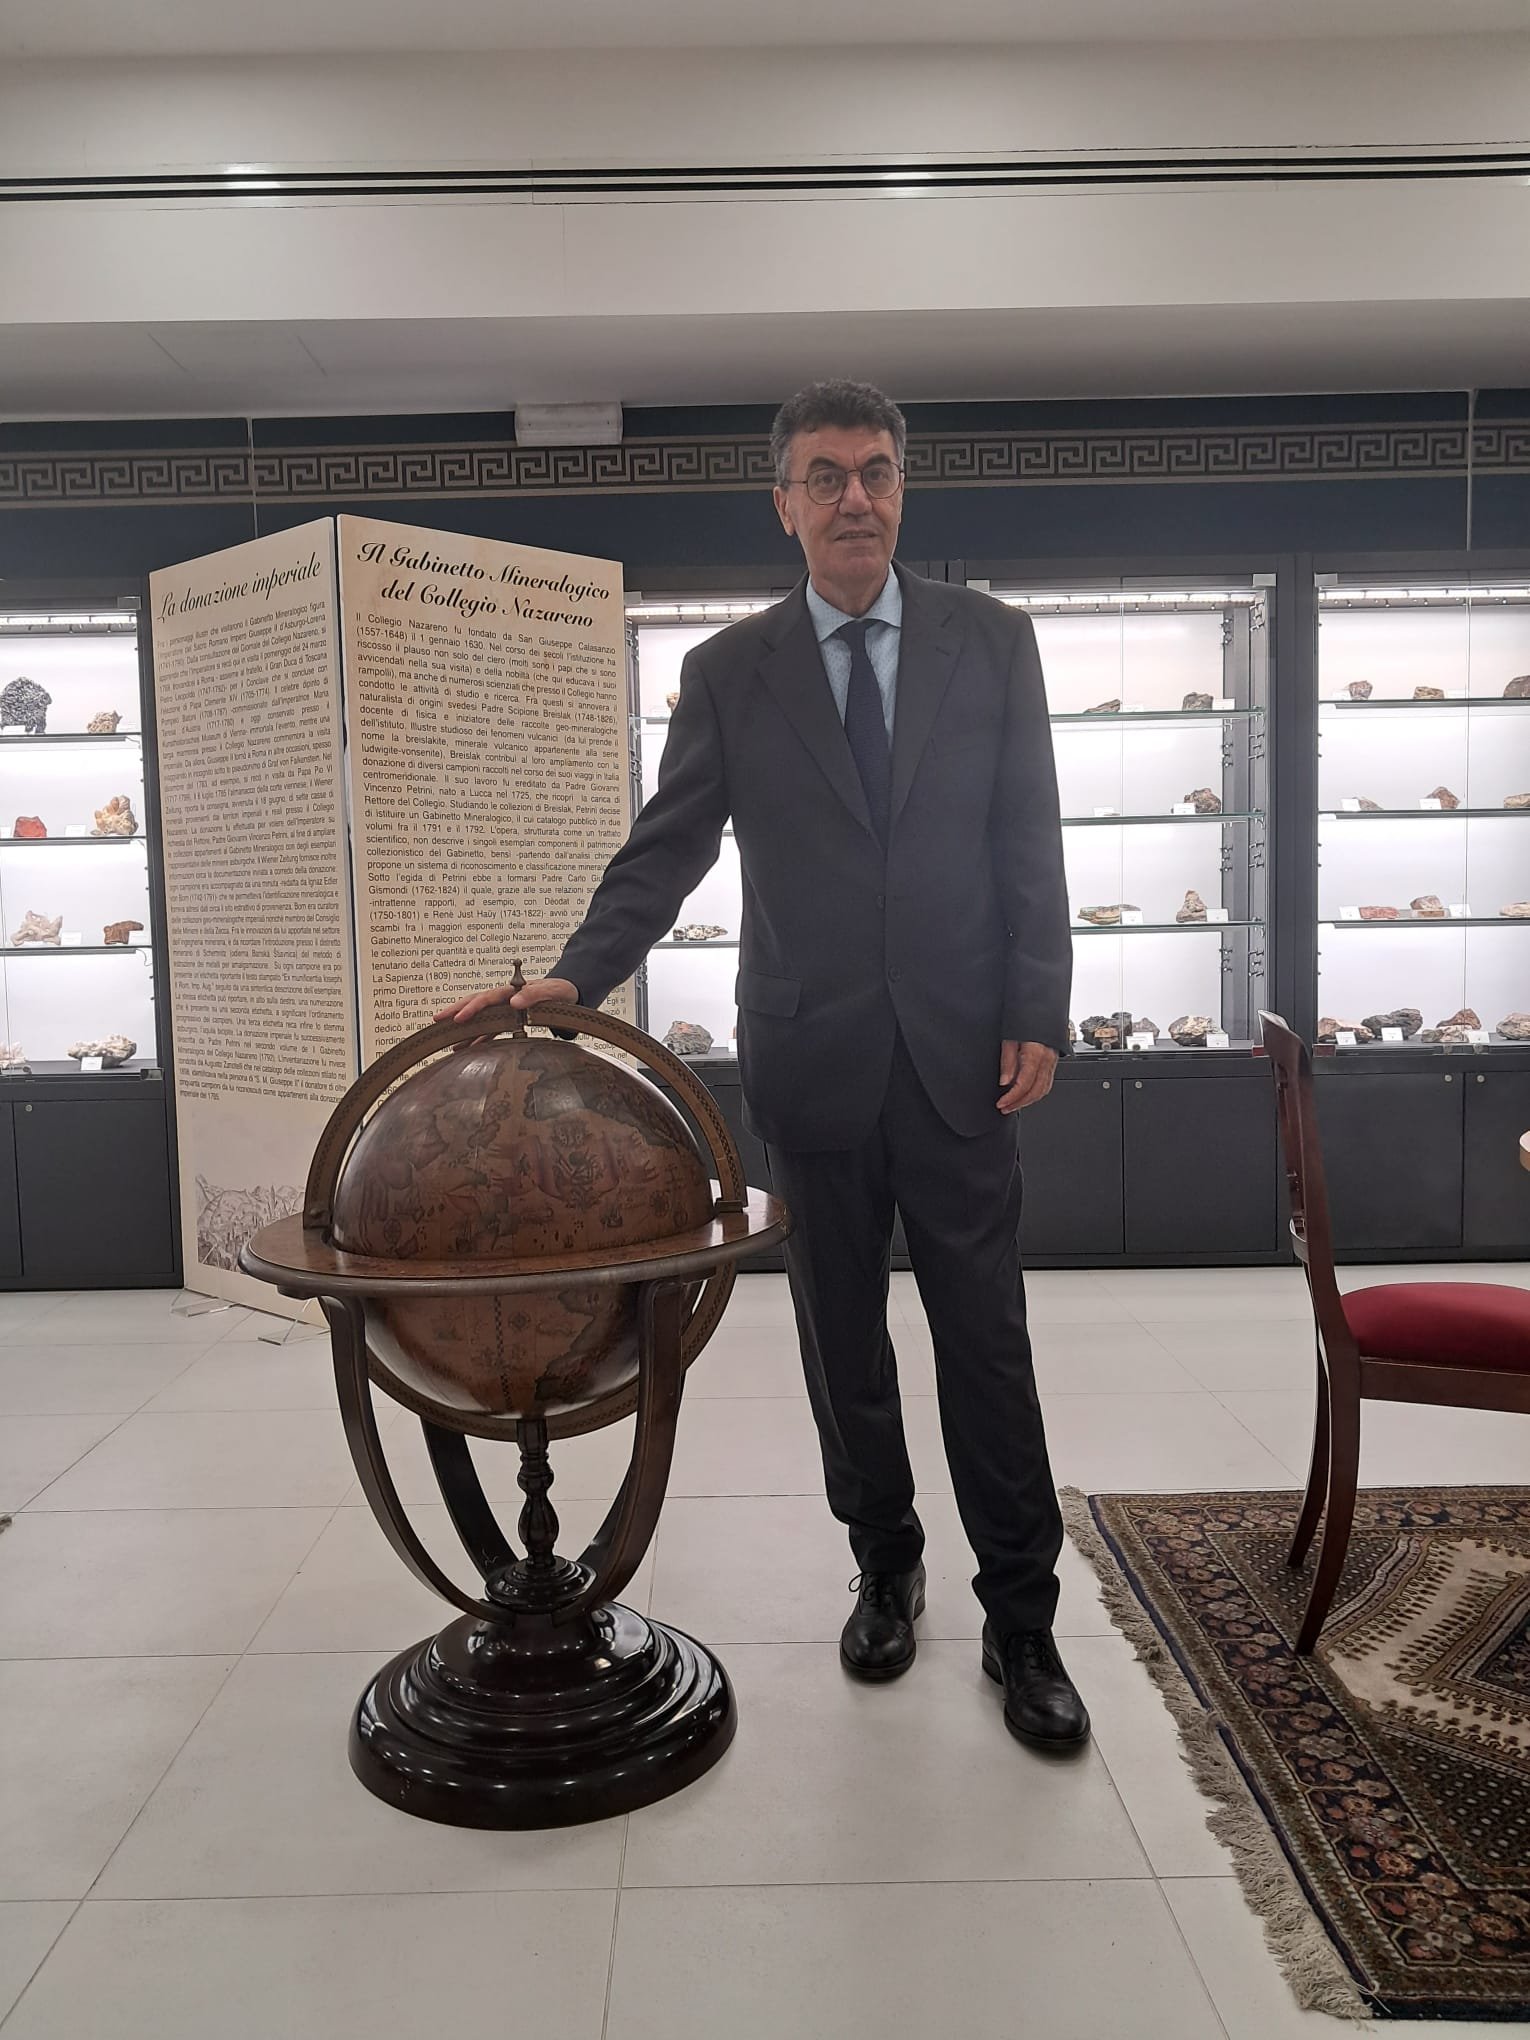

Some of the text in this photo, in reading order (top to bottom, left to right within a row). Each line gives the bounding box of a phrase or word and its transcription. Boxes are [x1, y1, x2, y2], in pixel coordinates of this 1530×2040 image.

[357, 542, 609, 602] Il Gabinetto Mineralogico
[157, 552, 320, 623] La donazione imperiale
[381, 580, 593, 627] del Collegio Nazareno
[356, 613, 615, 654] Il Collegio Nazareno fu fondato da San Giuseppe Calasanzio
[357, 639, 484, 662] riscosso il plauso non solo del
[411, 633, 416, 642] il
[428, 637, 460, 647] gennaio
[489, 642, 502, 652] Nel
[505, 646, 525, 655] corso
[358, 654, 405, 666] avvicendati
[408, 659, 428, 668] nella
[358, 680, 395, 690] condotto
[400, 683, 408, 692] le
[444, 687, 451, 696] di
[456, 689, 479, 699] studio
[359, 693, 539, 717] naturalista di svedesi Padre Scipione
[359, 705, 394, 716] docente
[401, 708, 408, 717] di
[416, 710, 436, 720] fisica
[456, 713, 490, 724] iniziatore
[497, 717, 514, 726] delle
[521, 720, 549, 729] raccolte
[361, 733, 528, 751] nome la minerale vulcanico
[362, 757, 443, 770] donazione diversi
[474, 776, 498, 785] lavoro
[565, 781, 586, 790] Padre
[364, 783, 402, 793] Vincenzo
[439, 787, 456, 796] nato
[469, 788, 492, 797] Lucca
[496, 790, 507, 798] nel
[535, 792, 548, 800] che
[364, 796, 488, 809] Rettore del Studiando
[364, 809, 372, 817] di
[422, 811, 461, 820] Gabinetto
[365, 822, 441, 832] volumi fra il 1791
[431, 836, 464, 845] descrive
[366, 848, 424, 856] collezionistico
[429, 848, 441, 857] del
[367, 862, 402, 871] propone
[417, 861, 448, 869] sistema
[368, 873, 390, 881] Sotto
[428, 873, 436, 881] di
[442, 873, 466, 881] Petrini
[472, 874, 491, 882] ebbe
[368, 886, 408, 894] Gismondi
[497, 886, 520, 896] grazie
[465, 898, 475, 906] ad
[457, 910, 473, 918] Just
[370, 923, 416, 932] scambi fra
[370, 933, 510, 945] Gabinetto Mineralogico del Collegio
[371, 949, 378, 958] le
[380, 948, 419, 957] collezioni
[421, 949, 434, 958] per
[410, 958, 475, 968] della Cattedra di
[372, 974, 383, 983] La
[385, 973, 423, 984] Sapienza
[485, 970, 512, 979] sempre
[373, 982, 493, 998] primo Direttore Conservatore
[373, 996, 456, 1009] Altra figura di spicco
[374, 1009, 434, 1020] Adolfo Brattina
